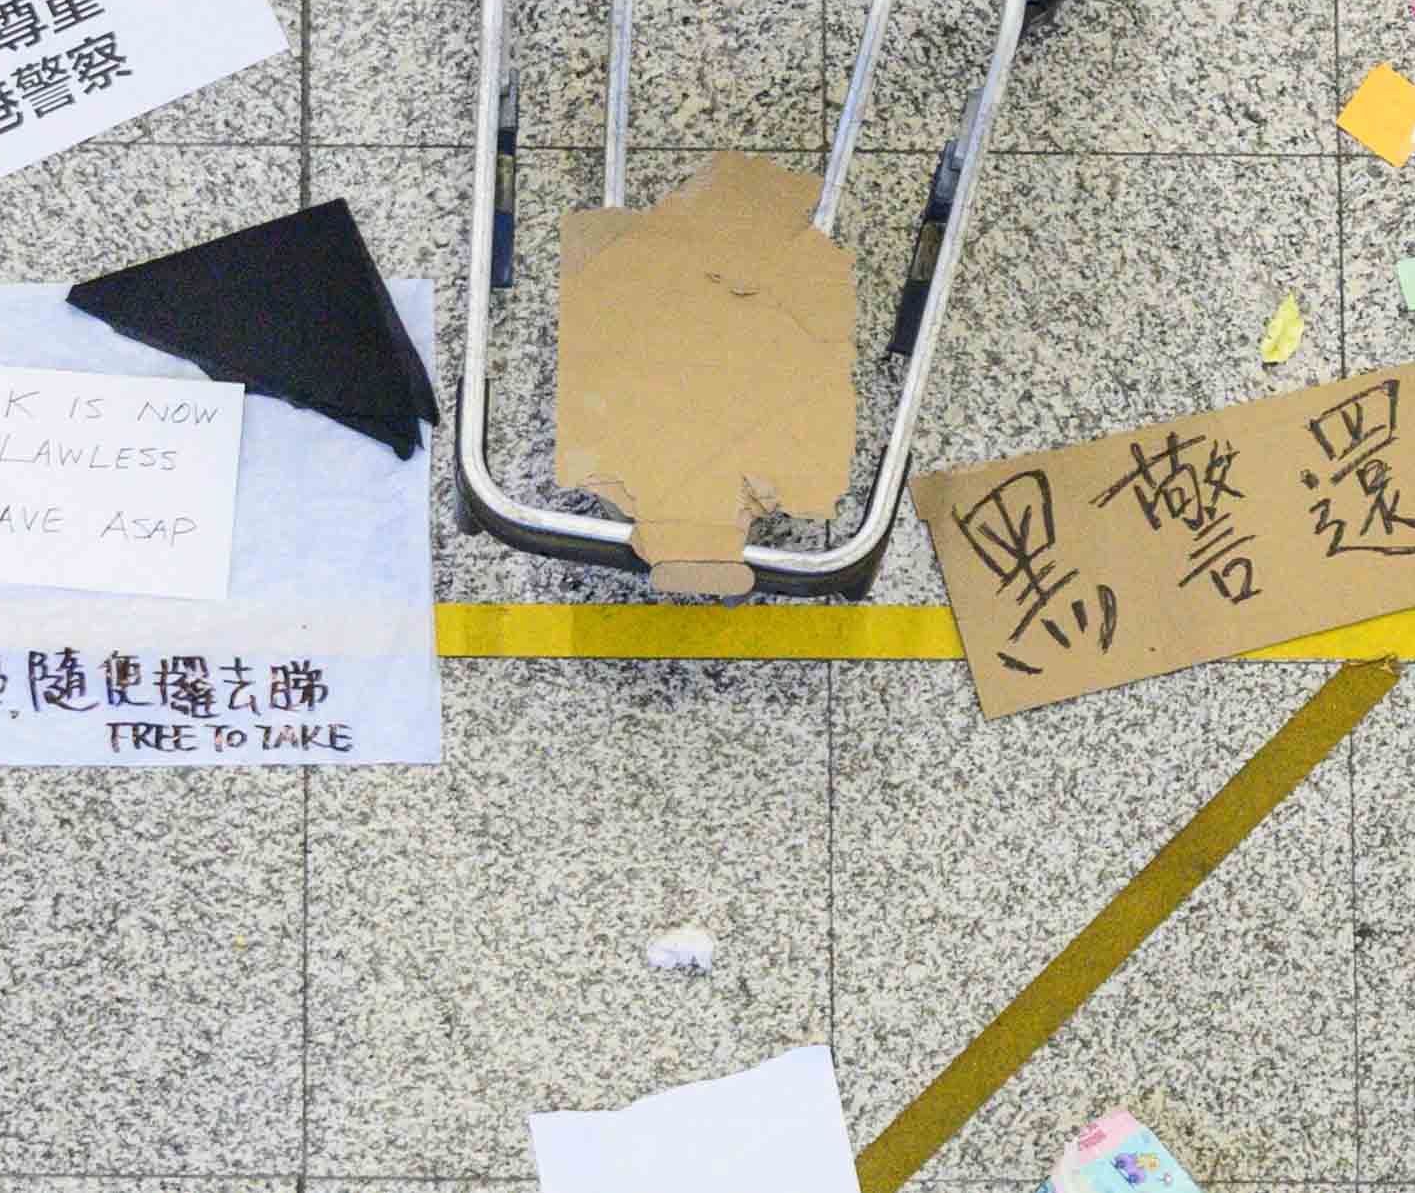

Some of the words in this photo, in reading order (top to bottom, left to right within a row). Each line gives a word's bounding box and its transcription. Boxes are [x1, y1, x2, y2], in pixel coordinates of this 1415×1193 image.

[69, 394, 106, 421] IS
[137, 399, 220, 426] NOW
[100, 510, 199, 548] ASAP
[105, 722, 199, 753] FREE
[256, 722, 354, 752] TAKE
